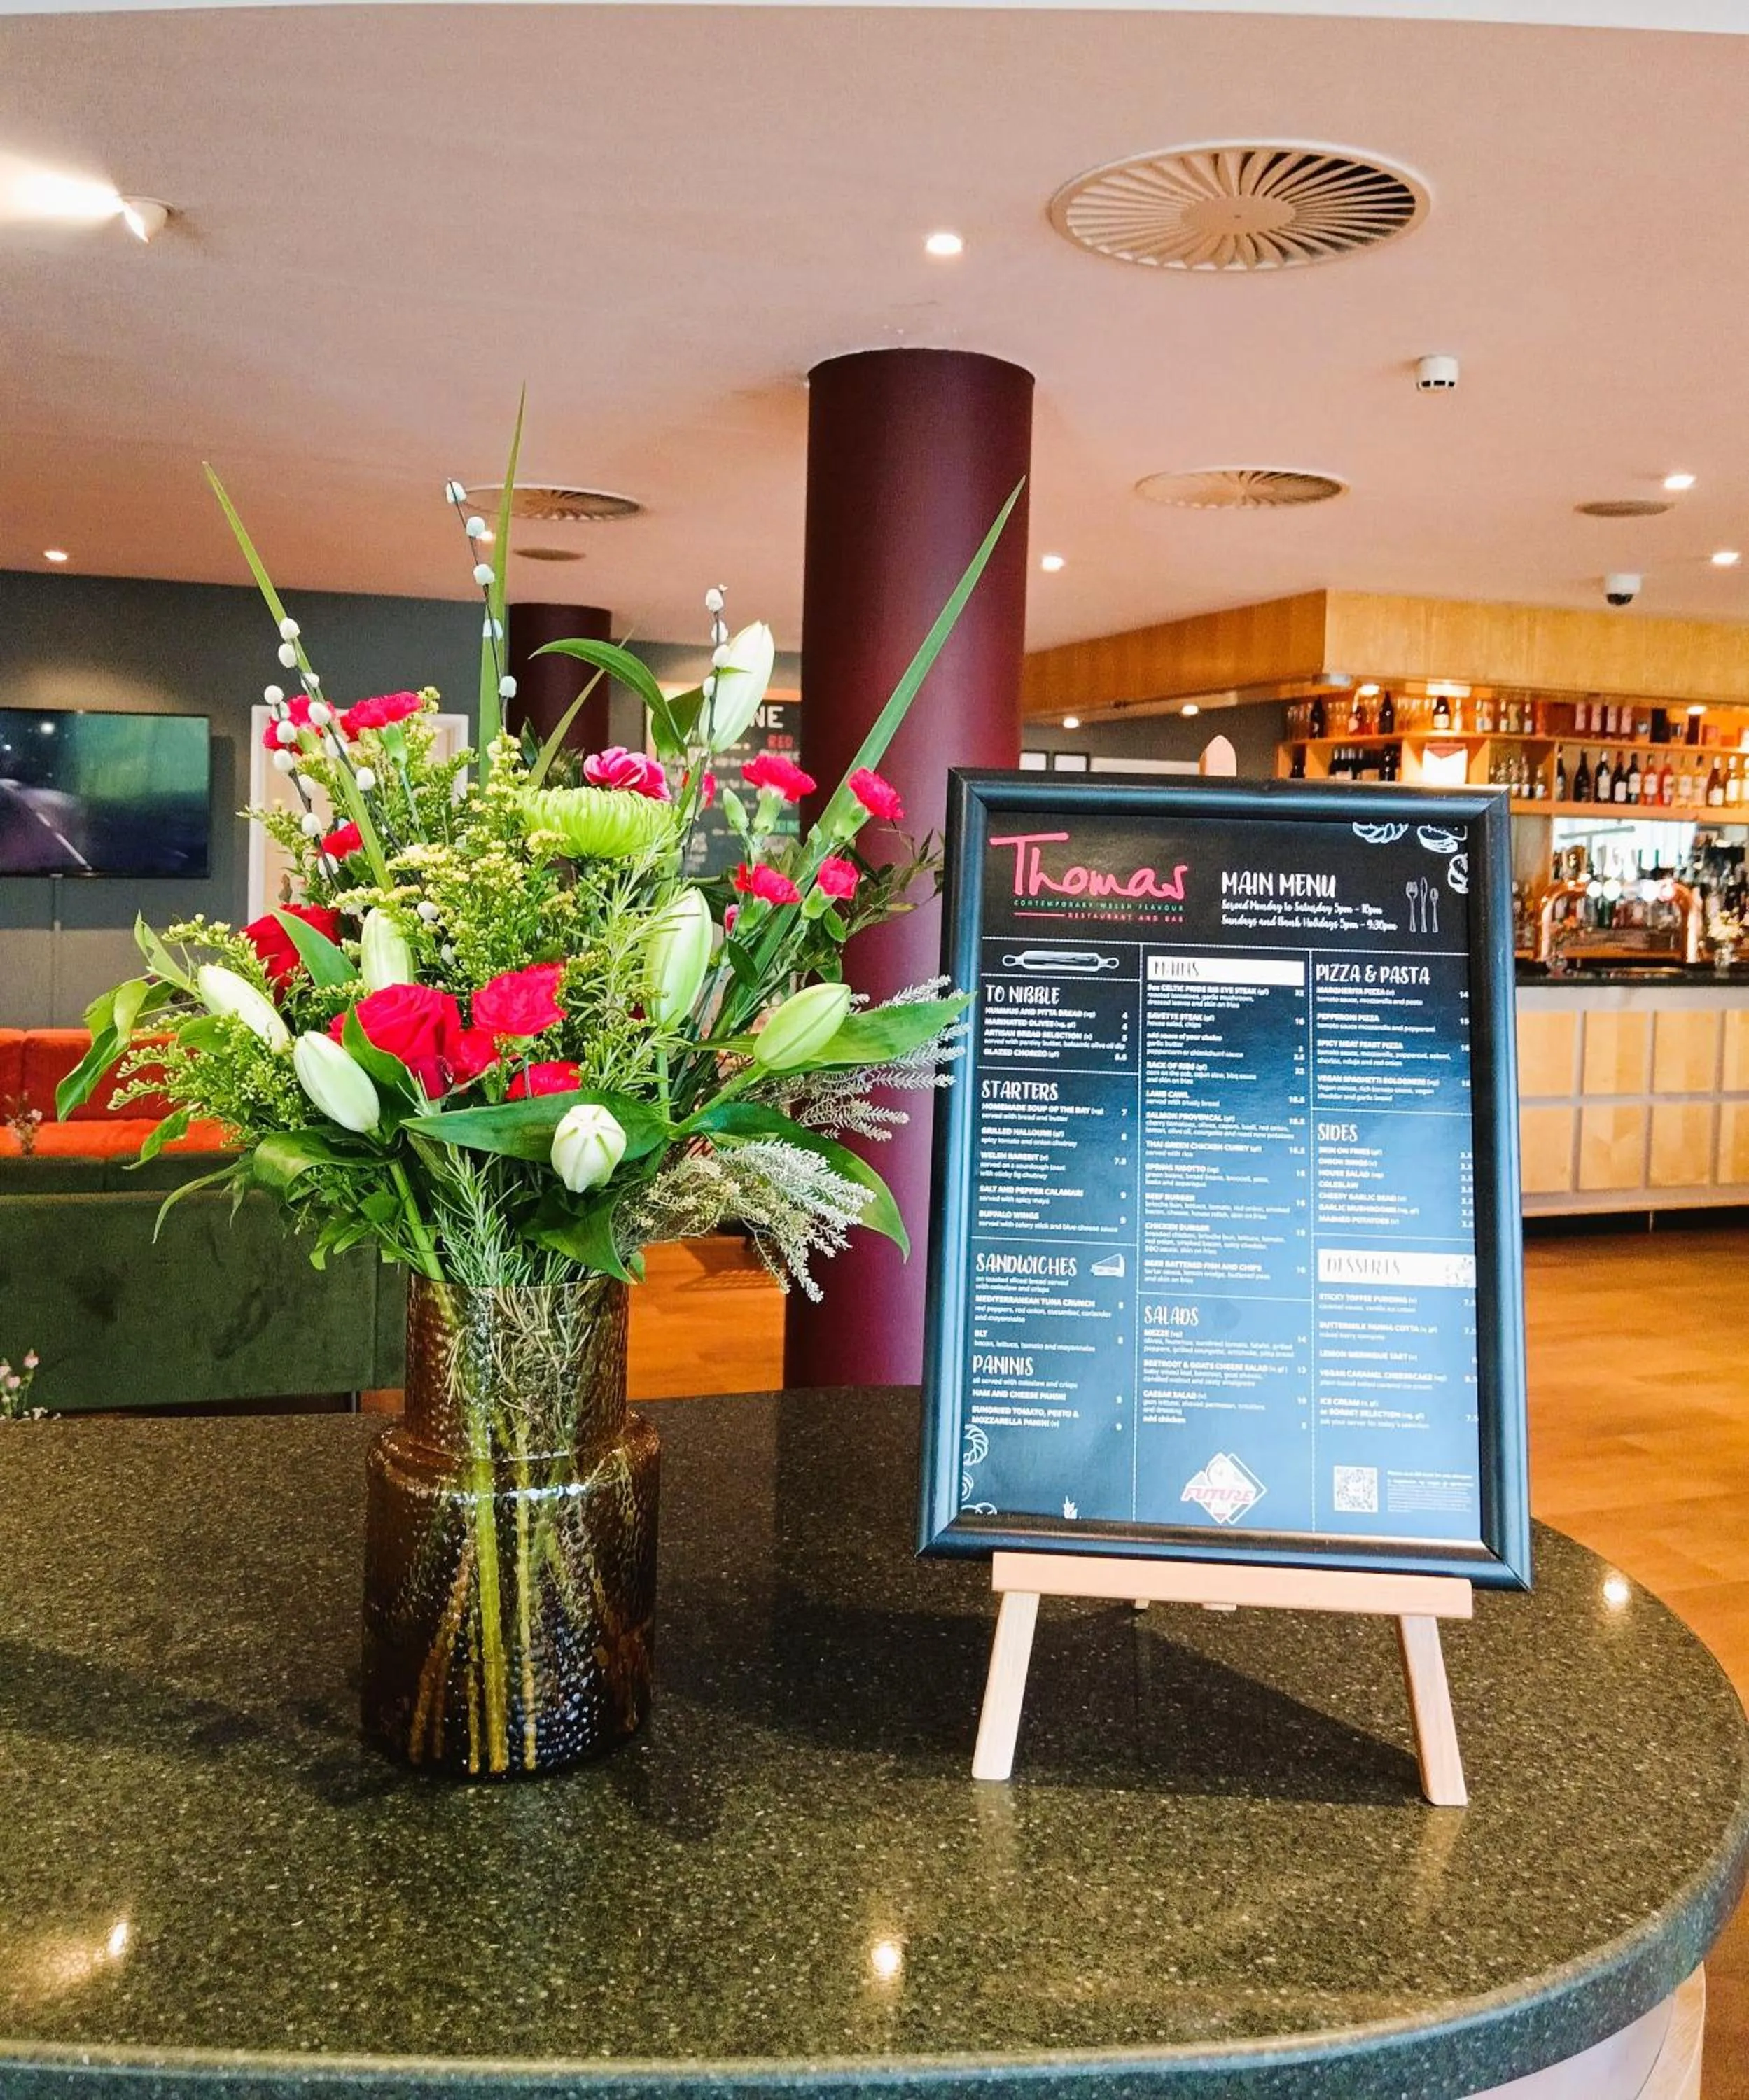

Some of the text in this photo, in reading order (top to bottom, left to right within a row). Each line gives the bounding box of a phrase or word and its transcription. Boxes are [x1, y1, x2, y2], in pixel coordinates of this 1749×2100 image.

[989, 832, 1188, 900] Thomas
[1222, 871, 1336, 899] MAIN MENU
[1014, 899, 1093, 908] CONTEMPORARY
[1138, 903, 1184, 911] FLAVOUR
[1222, 899, 1249, 911] Served
[1250, 899, 1283, 913] Monday
[1283, 901, 1293, 911] to
[1294, 901, 1332, 915] Saturday
[1334, 902, 1353, 915] 5pm
[1361, 903, 1383, 916] 10pm
[1067, 912, 1132, 921] RESTAURANT
[1222, 913, 1257, 928] Sundays
[1259, 915, 1276, 926] and
[1278, 916, 1302, 927] Bank
[1303, 916, 1339, 931] Holidays
[1339, 918, 1359, 931] 5pm
[1316, 963, 1430, 985] PIZZA & PASTA
[987, 984, 1059, 1004] TO NIBBLE
[982, 1080, 1058, 1101] STARTERS
[1318, 1123, 1357, 1142] SIDES
[976, 1253, 1077, 1276] SANDWICHES
[1144, 1305, 1199, 1326] SALADS
[973, 1354, 1033, 1376] PANINIS
